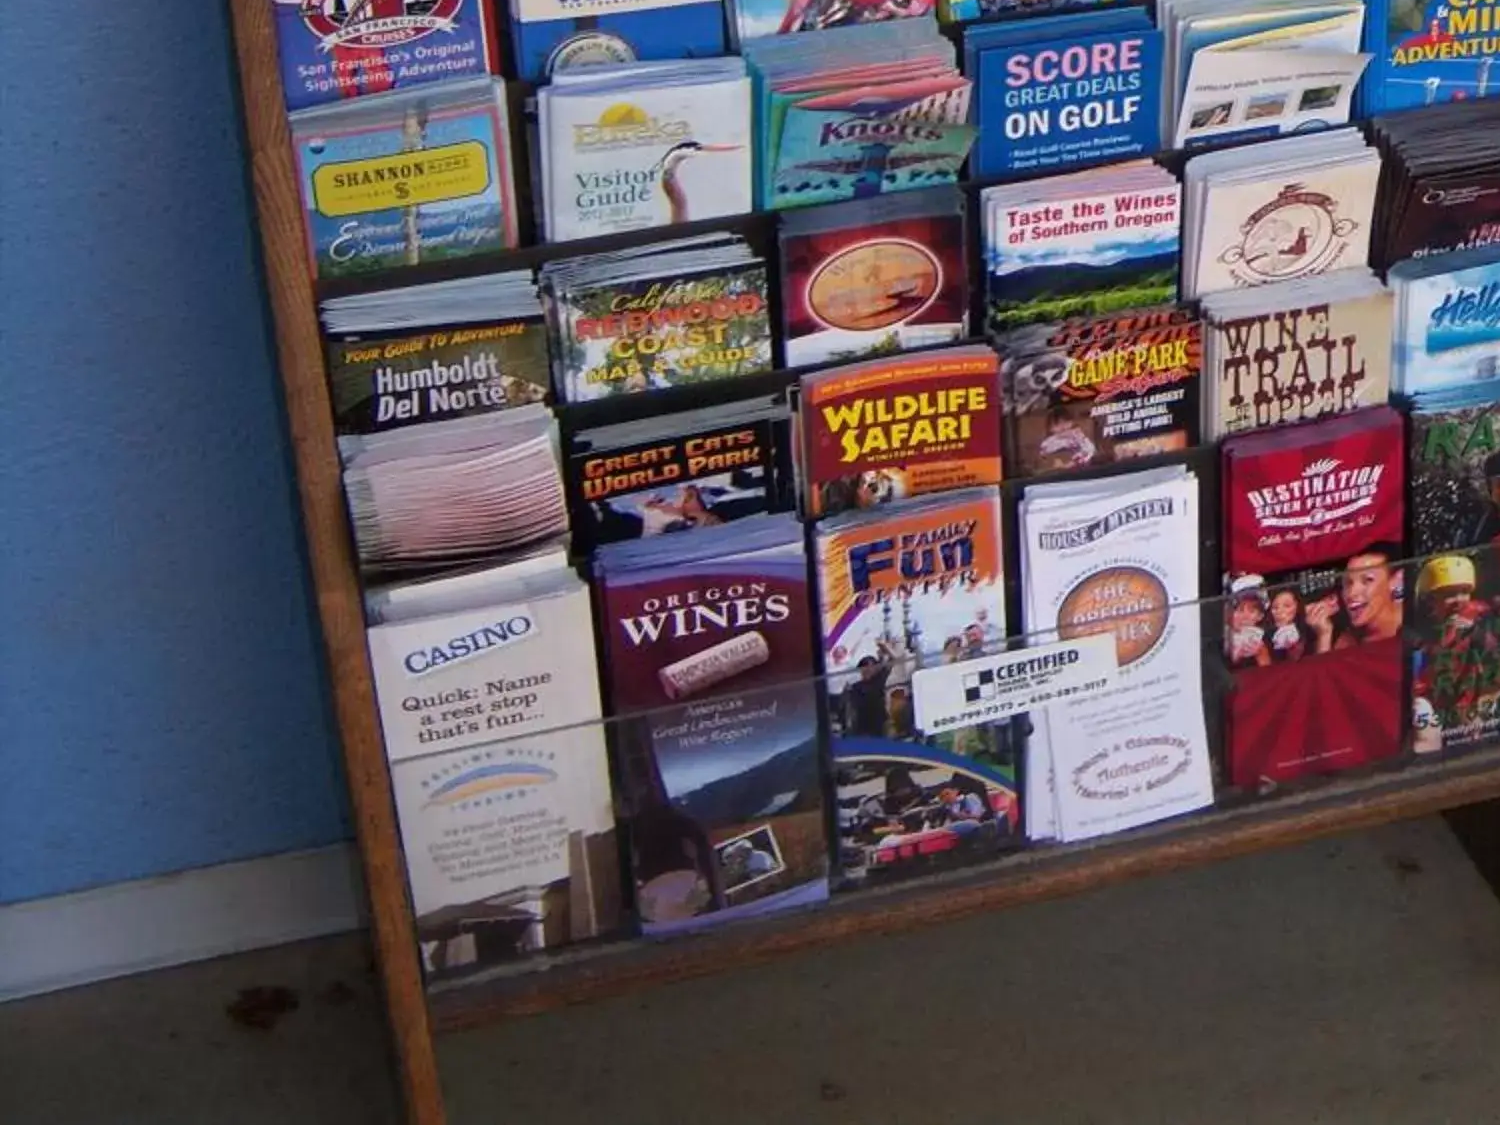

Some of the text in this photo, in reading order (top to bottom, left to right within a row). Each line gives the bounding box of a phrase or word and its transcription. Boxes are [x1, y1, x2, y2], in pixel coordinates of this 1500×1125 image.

[336, 17, 438, 39] SAN FRANCISCO
[297, 39, 475, 77] San Francisco's Original
[305, 55, 477, 92] Sightseeing Adventure
[1004, 38, 1144, 87] SCORE
[1004, 72, 1141, 107] GREAT DEALS
[1005, 95, 1141, 139] ON GOLF
[333, 162, 425, 189] SHANNON
[576, 169, 657, 189] Visitor
[576, 186, 653, 208] Guide
[1007, 193, 1177, 228] Taste the Wines
[1008, 211, 1175, 243] of Southern Oregon
[575, 293, 761, 339] REDWOOD
[1223, 303, 1330, 354] WINE
[344, 322, 526, 363] YOUR GUIDE TO ADVENTURE
[612, 323, 729, 359] COAST
[376, 351, 500, 394] Humboldt
[586, 361, 641, 384] MAP
[681, 346, 756, 368] GUIDE
[1070, 339, 1190, 387] GAME PARK
[1224, 334, 1365, 406] TRAIL
[377, 383, 508, 422] Del Norte
[821, 386, 988, 432] WILDLIFE
[584, 430, 755, 478] GREAT CATS
[840, 414, 971, 462] SAFARI
[583, 447, 760, 499] WORLD PARK
[1247, 464, 1385, 508] DESTINATION
[1255, 483, 1378, 519] SEVEN FEATHERS
[902, 520, 977, 549] FAMILY
[1039, 498, 1173, 550] HOUSE MYSTERY
[848, 538, 975, 592] Fun
[642, 582, 767, 612] OREGON
[1093, 580, 1131, 600] THE
[619, 594, 790, 646] WINES
[404, 616, 531, 674] CASINO
[995, 649, 1080, 681] CERTIFIED
[402, 672, 552, 712] Quick: Name
[420, 691, 538, 726] a rest stop
[418, 723, 480, 744] that's
